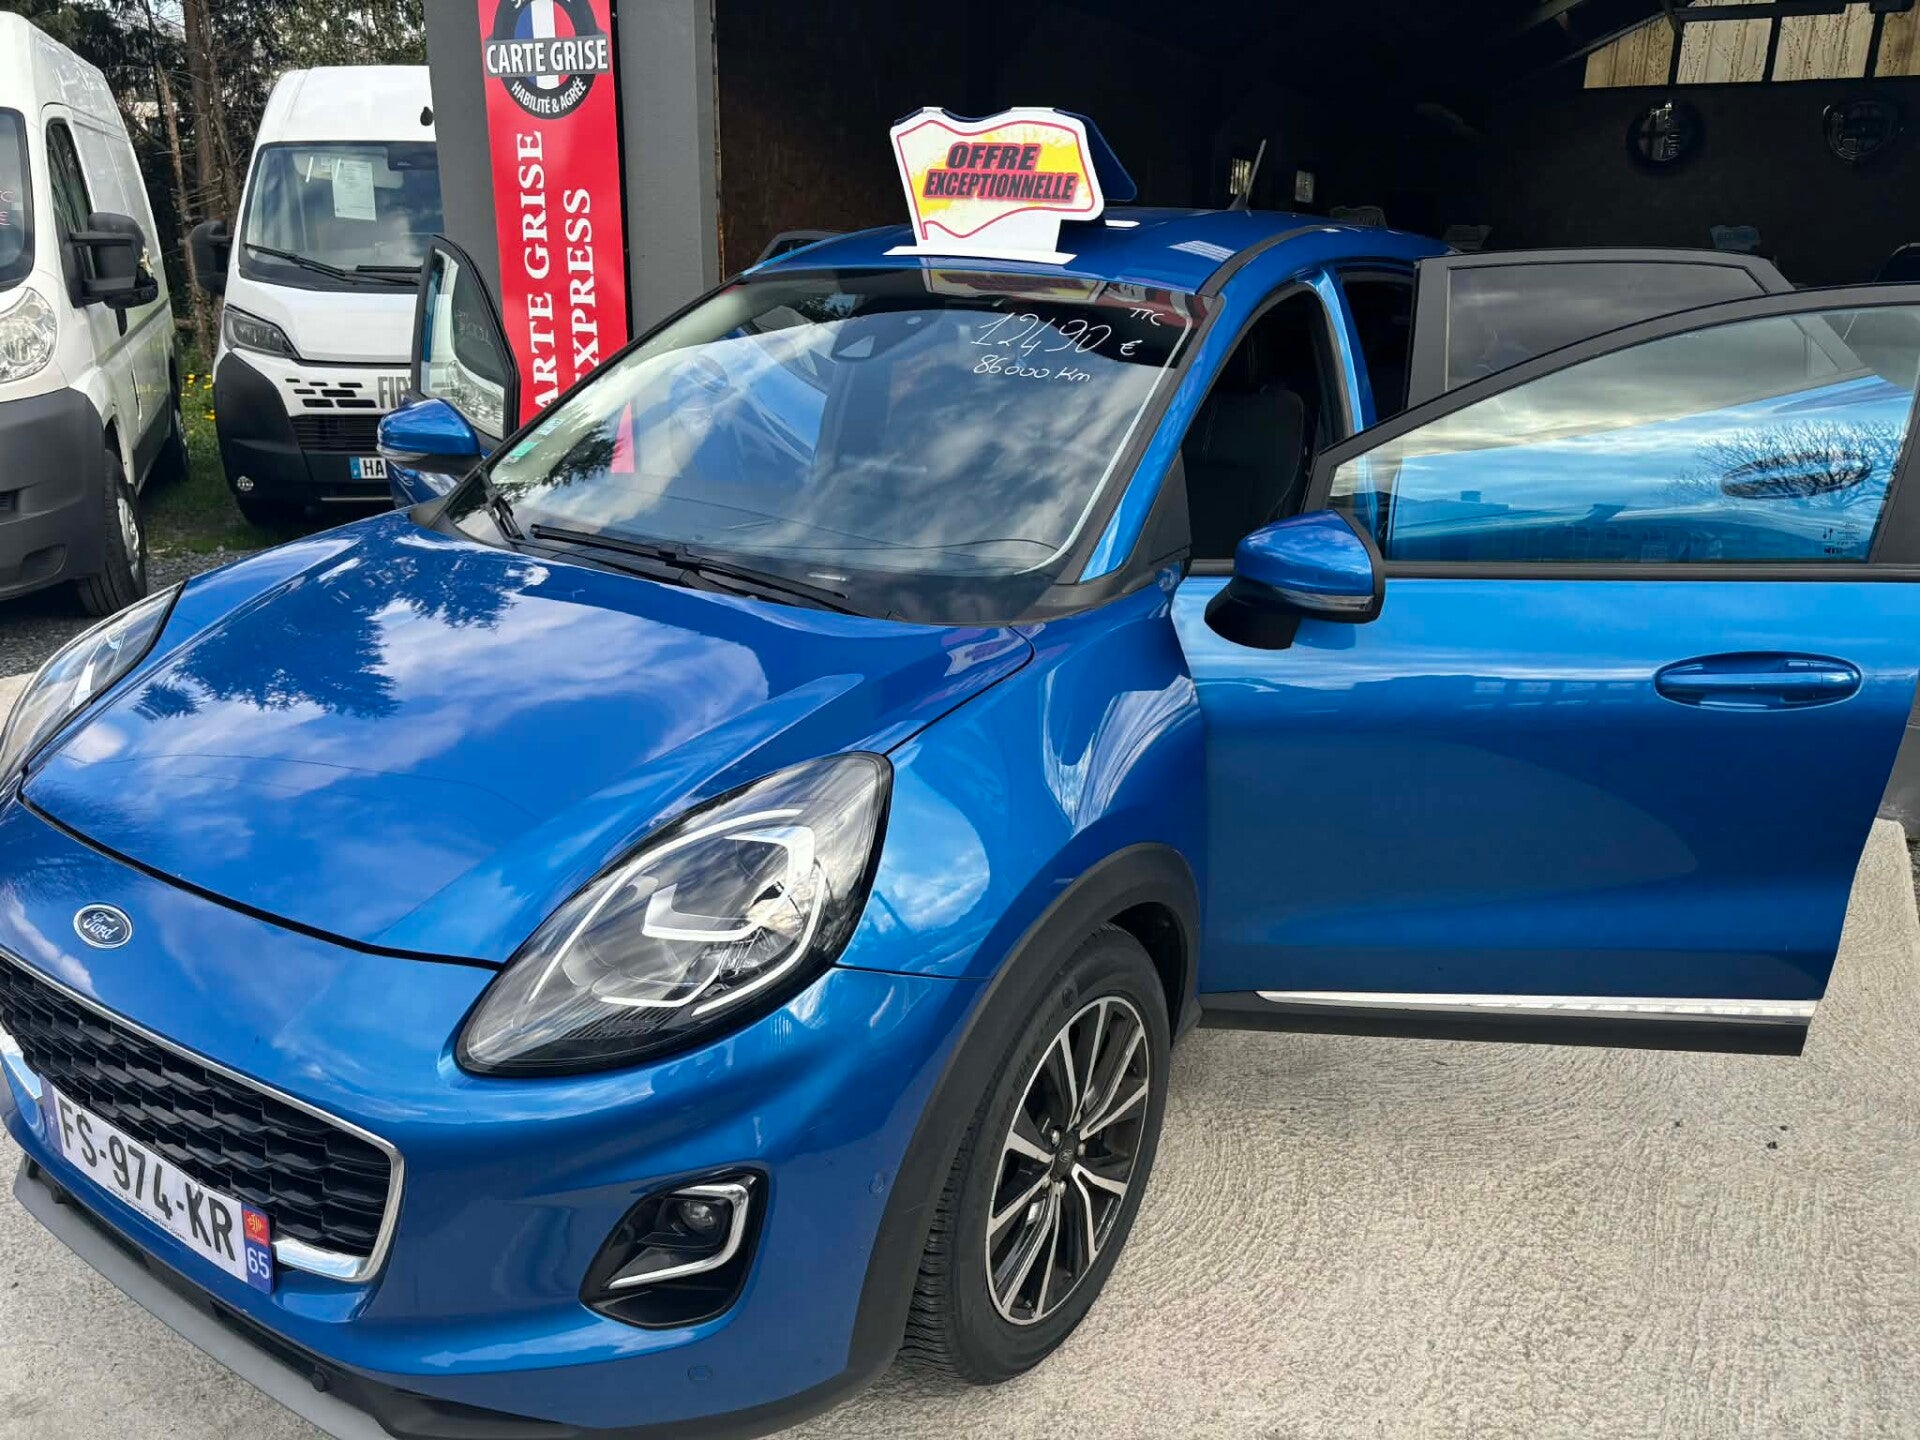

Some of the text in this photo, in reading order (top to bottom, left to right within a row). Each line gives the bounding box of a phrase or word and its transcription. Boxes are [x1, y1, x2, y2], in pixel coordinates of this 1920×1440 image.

[486, 40, 608, 73] CARTE GRISE
[511, 80, 551, 114] HABILITÉ
[551, 98, 560, 113] &
[948, 143, 1040, 171] OFFRE
[925, 171, 1077, 200] EXCEPTIONNELLE
[516, 131, 550, 279] GRISE
[563, 188, 600, 382] XPRESS
[1129, 307, 1165, 327] TTC
[527, 292, 559, 408] ARTE
[970, 311, 1143, 358] 12490 €
[973, 354, 1050, 379] 86000
[377, 376, 411, 409] FIA
[363, 460, 385, 476] HA
[83, 911, 120, 940] Ford
[58, 1097, 237, 1263] FS-974-KR
[247, 1246, 270, 1280] 65
